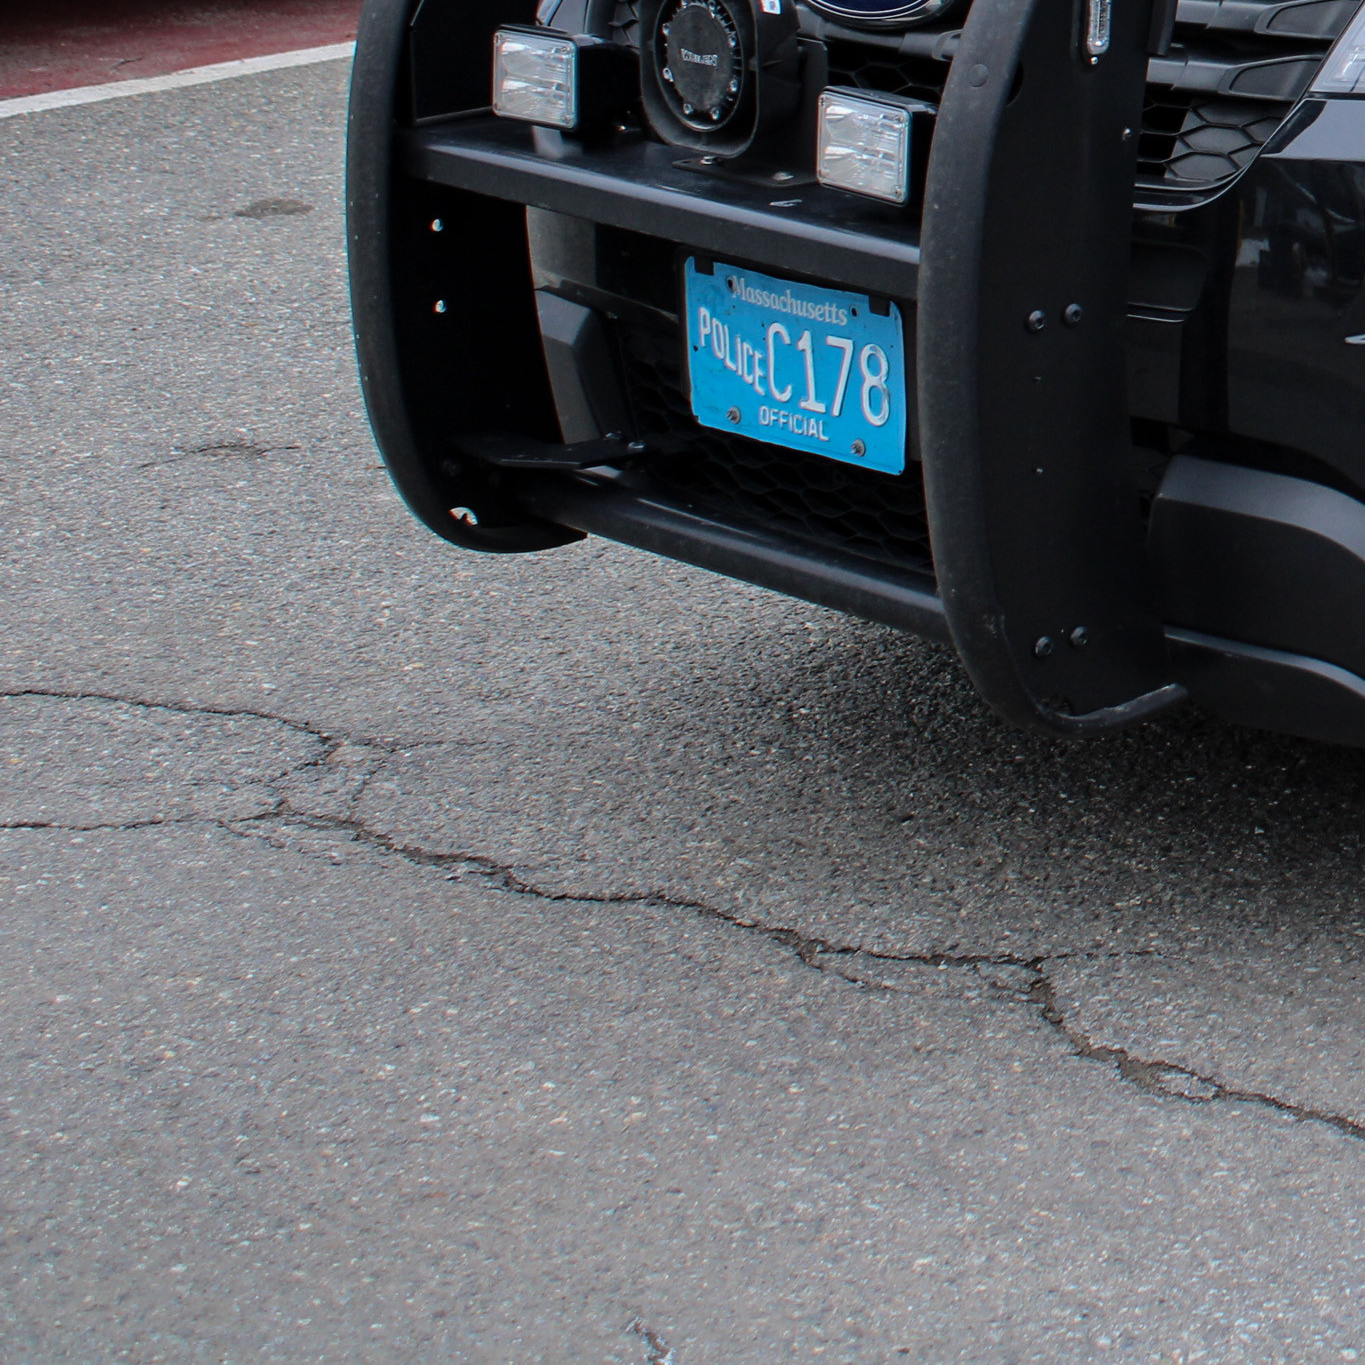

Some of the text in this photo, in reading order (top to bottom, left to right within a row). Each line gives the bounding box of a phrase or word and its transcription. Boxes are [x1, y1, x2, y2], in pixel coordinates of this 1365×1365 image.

[731, 275, 848, 326] Massachusetts
[699, 307, 890, 427] POLICE C178
[759, 405, 830, 442] OFFICIAL
